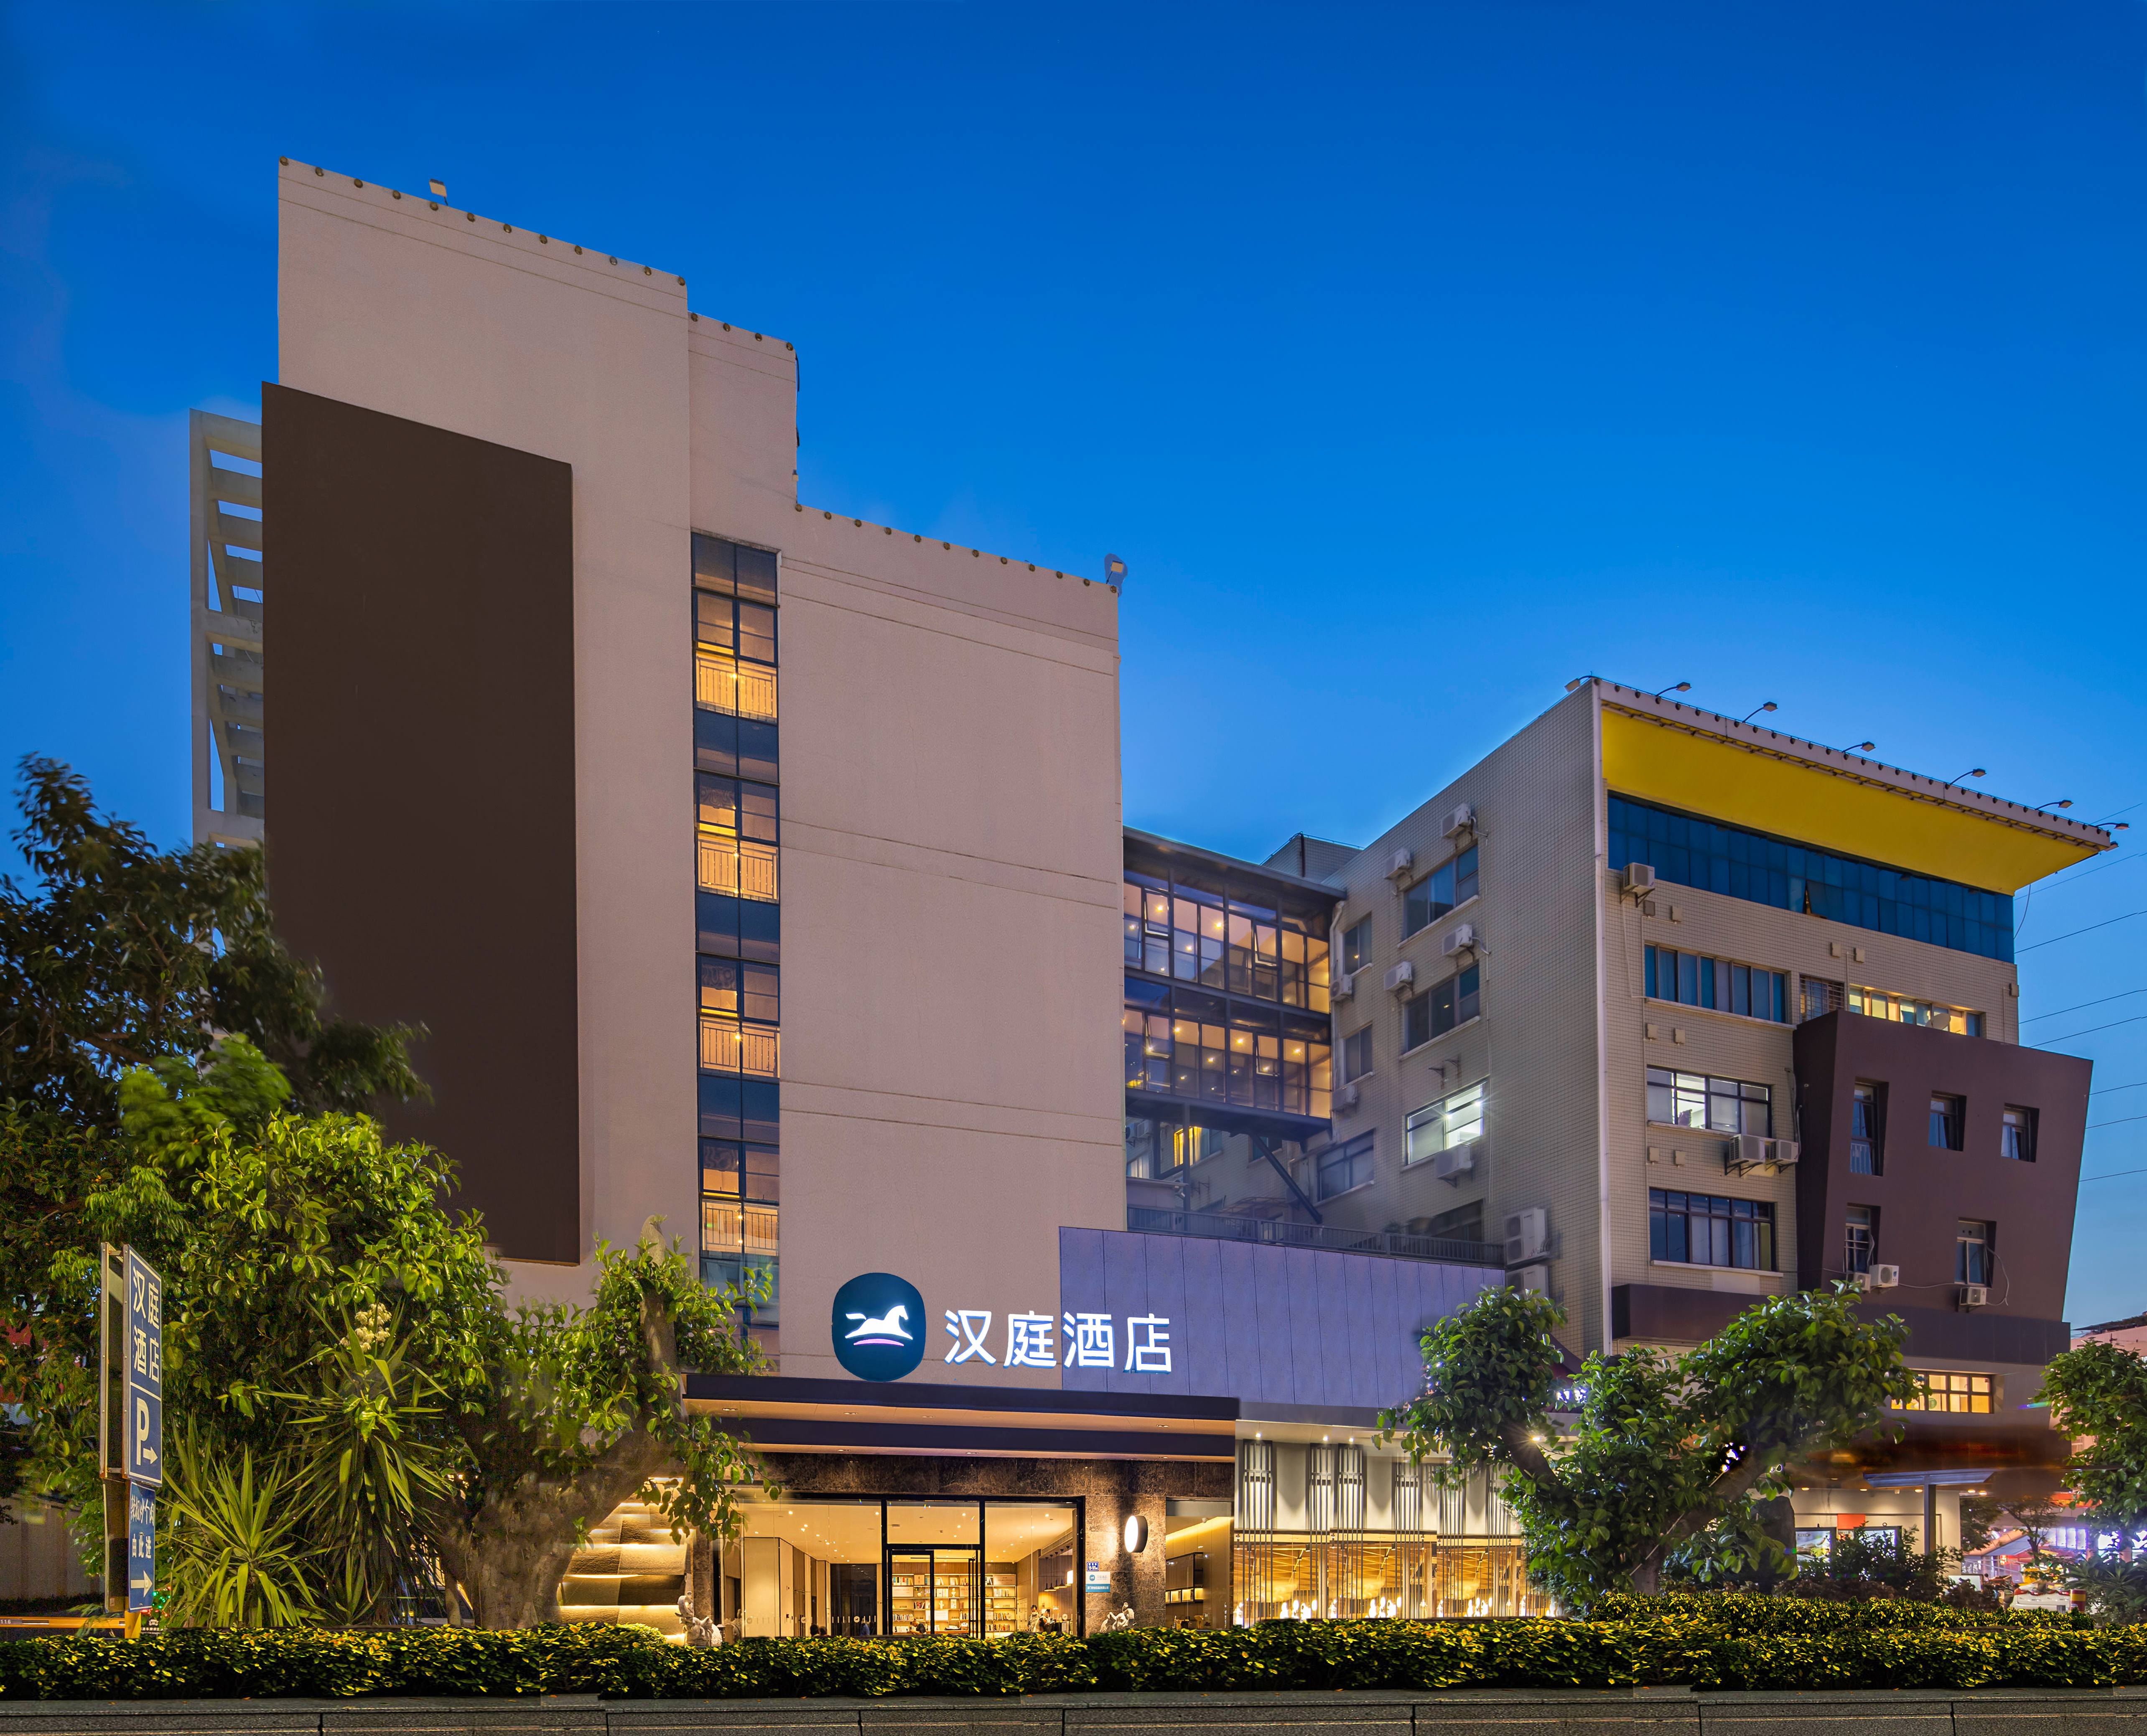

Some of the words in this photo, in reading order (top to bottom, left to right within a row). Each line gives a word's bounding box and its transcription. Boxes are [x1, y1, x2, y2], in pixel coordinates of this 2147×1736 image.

[133, 1265, 159, 1329] 汉庭
[133, 1324, 159, 1384] 酒店
[944, 1309, 1172, 1374] 汉庭酒店
[136, 1397, 149, 1466] P
[132, 1532, 152, 1559] 由此进
